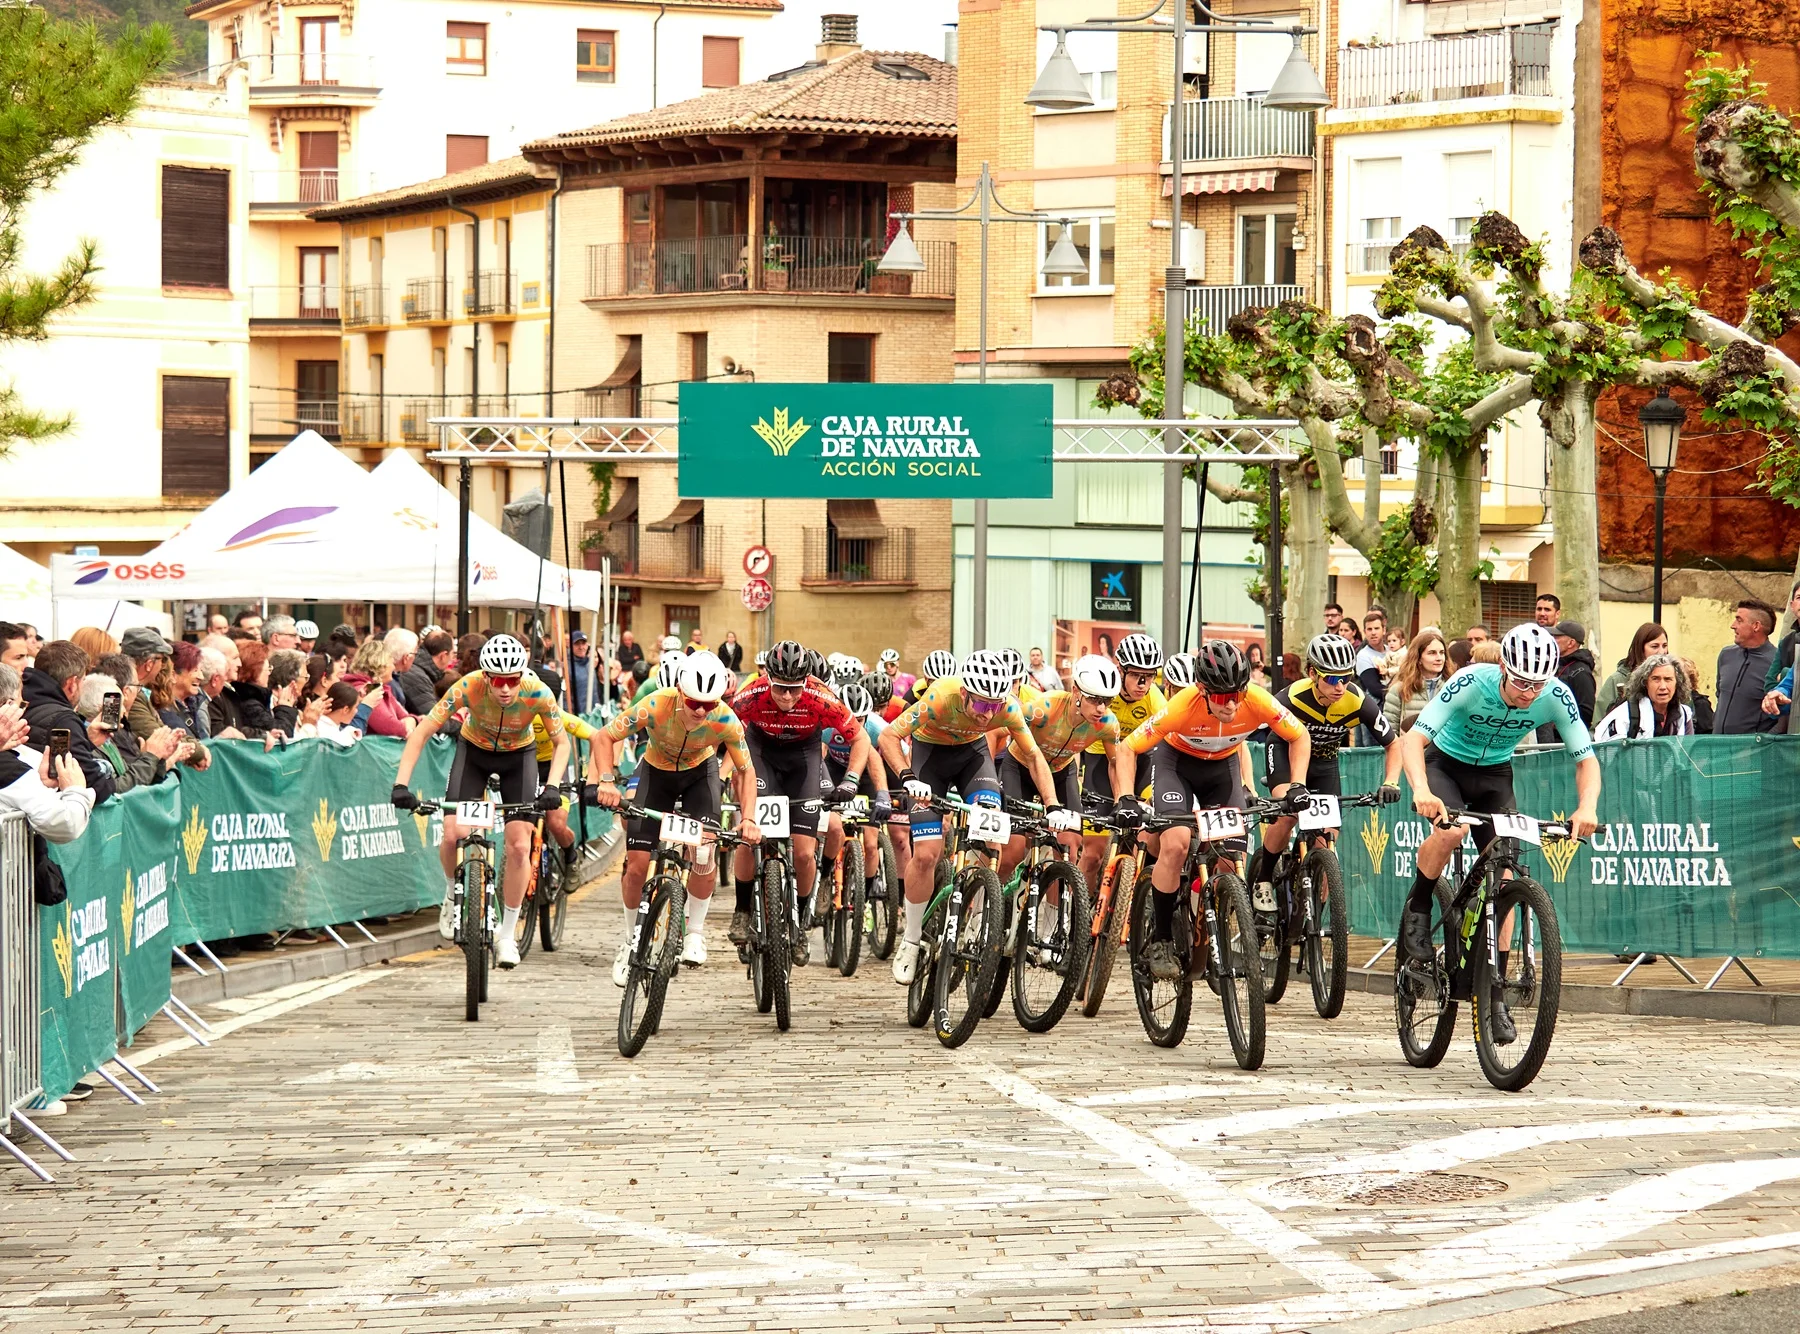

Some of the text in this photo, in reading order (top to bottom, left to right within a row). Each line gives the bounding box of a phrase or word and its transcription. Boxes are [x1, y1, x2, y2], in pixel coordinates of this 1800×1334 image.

[821, 415, 969, 437] CAJA RURAL
[821, 438, 981, 457] DE NAVARRA
[822, 459, 981, 476] ACCIÓN SOCIAL
[1094, 600, 1132, 612] CaixaBank
[340, 806, 368, 834] CAJA
[369, 803, 399, 830] RURAL
[462, 802, 489, 819] 121
[758, 803, 781, 826] 29
[1309, 798, 1330, 817] 35
[211, 813, 245, 843] CAJA
[667, 815, 698, 836] 118
[979, 811, 1001, 832] 25
[1201, 809, 1239, 831] 119
[1503, 814, 1528, 831] 10
[341, 830, 405, 860] DE NAVARRA
[1642, 823, 1719, 852] RURAL
[211, 842, 296, 873] DE NAVARRA
[1395, 852, 1412, 877] DE
[1591, 857, 1732, 886] DE NAVARRA
